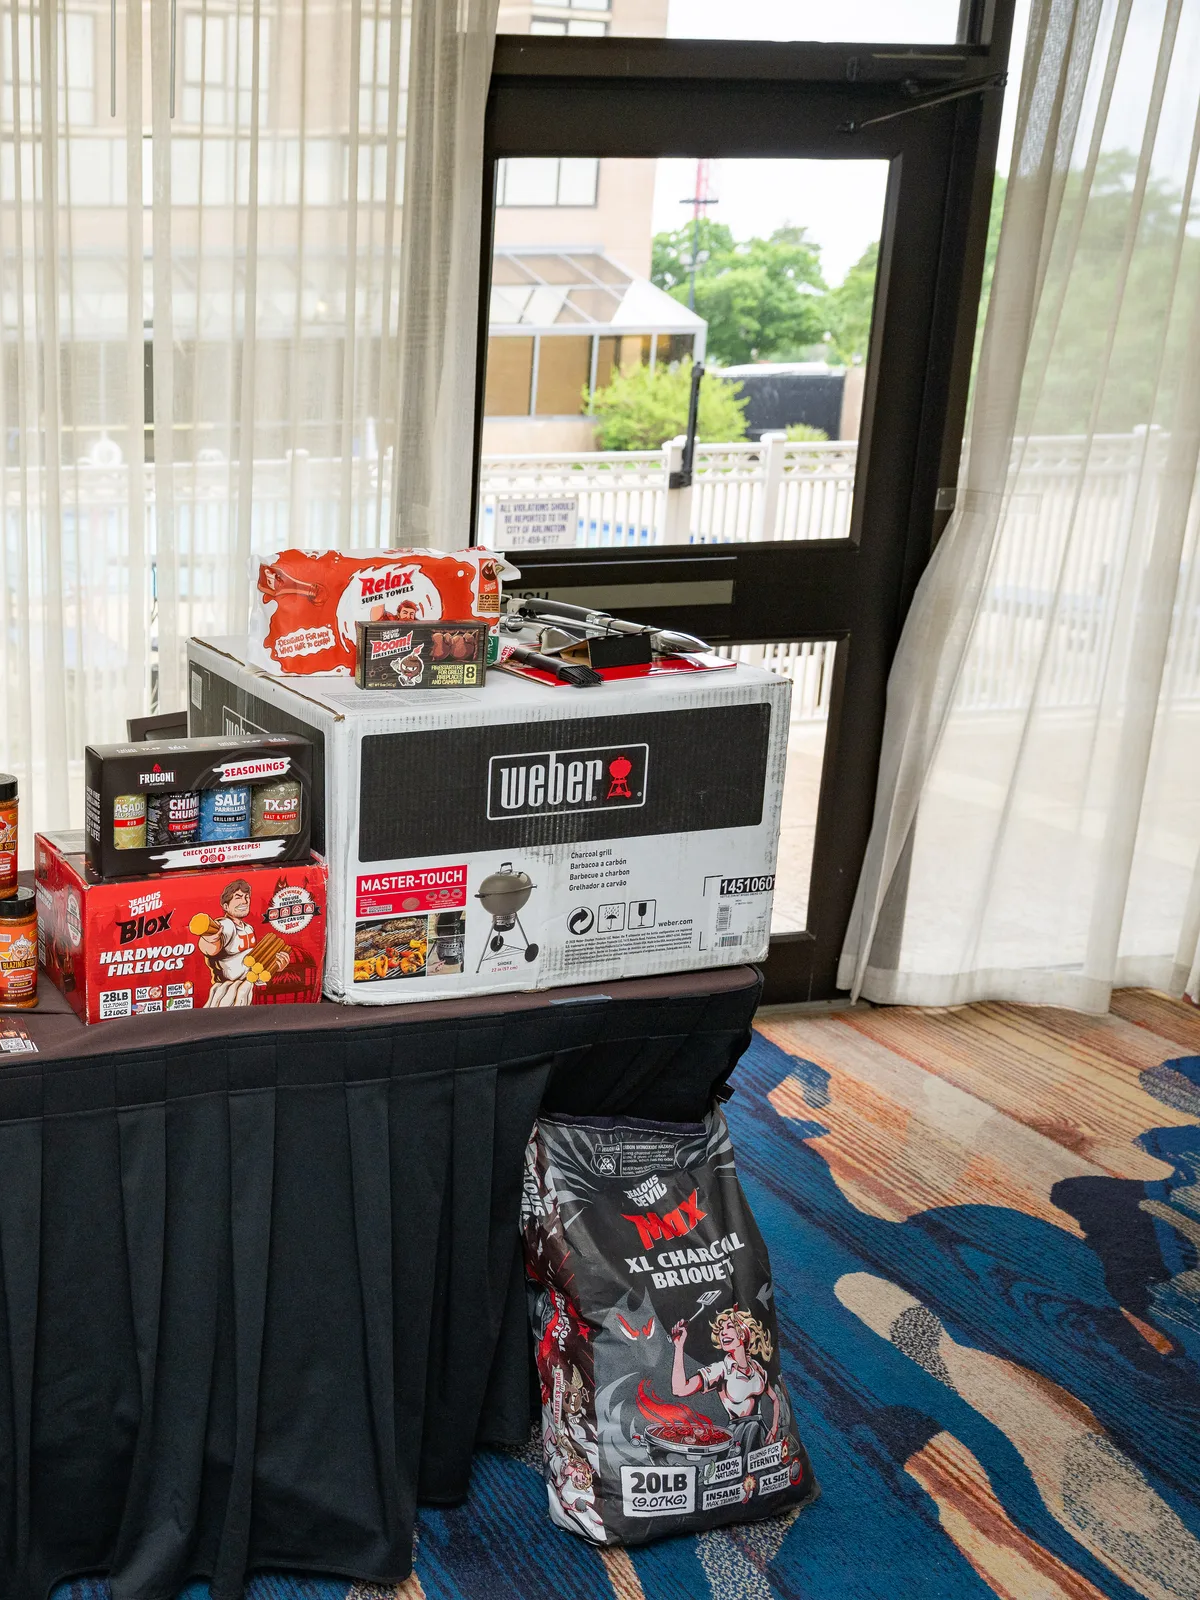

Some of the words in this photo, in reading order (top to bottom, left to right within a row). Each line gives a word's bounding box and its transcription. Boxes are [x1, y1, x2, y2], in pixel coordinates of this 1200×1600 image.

[358, 570, 415, 597] Relax
[361, 595, 384, 604] SUPER
[386, 585, 414, 598] TOWELS
[371, 631, 413, 654] Boom!
[465, 666, 475, 679] 8
[224, 761, 285, 778] SEASONINGS
[139, 771, 175, 784] FRUGONI
[500, 752, 602, 810] weber
[214, 792, 246, 807] SALT
[264, 798, 298, 811] TX.SP
[182, 849, 203, 857] CHECK
[233, 843, 261, 851] RECIPES!
[570, 850, 598, 859] Charcoal
[599, 849, 612, 858] grill
[570, 861, 599, 870] Barbacoa
[605, 859, 627, 867] carbón
[361, 870, 463, 893] MASTER-TOUCH
[569, 872, 599, 881] Barbecue
[605, 869, 630, 877] charbon
[569, 882, 600, 891] Grelhador
[606, 880, 627, 888] carvão
[128, 891, 161, 909] JEALOUS
[130, 899, 163, 917] DEVIL
[115, 907, 174, 946] Blox
[658, 918, 693, 927] weber.com
[99, 943, 196, 965] HARDWOOD
[107, 957, 185, 977] FIRELOGS
[102, 991, 129, 1003] 28LB
[623, 1174, 659, 1199] JEALOUS
[620, 1188, 708, 1251] Max
[624, 1256, 655, 1274] XL
[768, 1446, 779, 1455] FOR
[716, 1460, 740, 1473] 100%
[749, 1453, 781, 1470] ETERNITY
[715, 1467, 740, 1480] NATURAL
[762, 1478, 773, 1487] XL
[773, 1471, 789, 1485] SIZE
[630, 1472, 688, 1494] 20LB
[632, 1494, 688, 1508] (9.07KG)
[706, 1487, 741, 1502] INSANE
[706, 1500, 720, 1508] MAX
